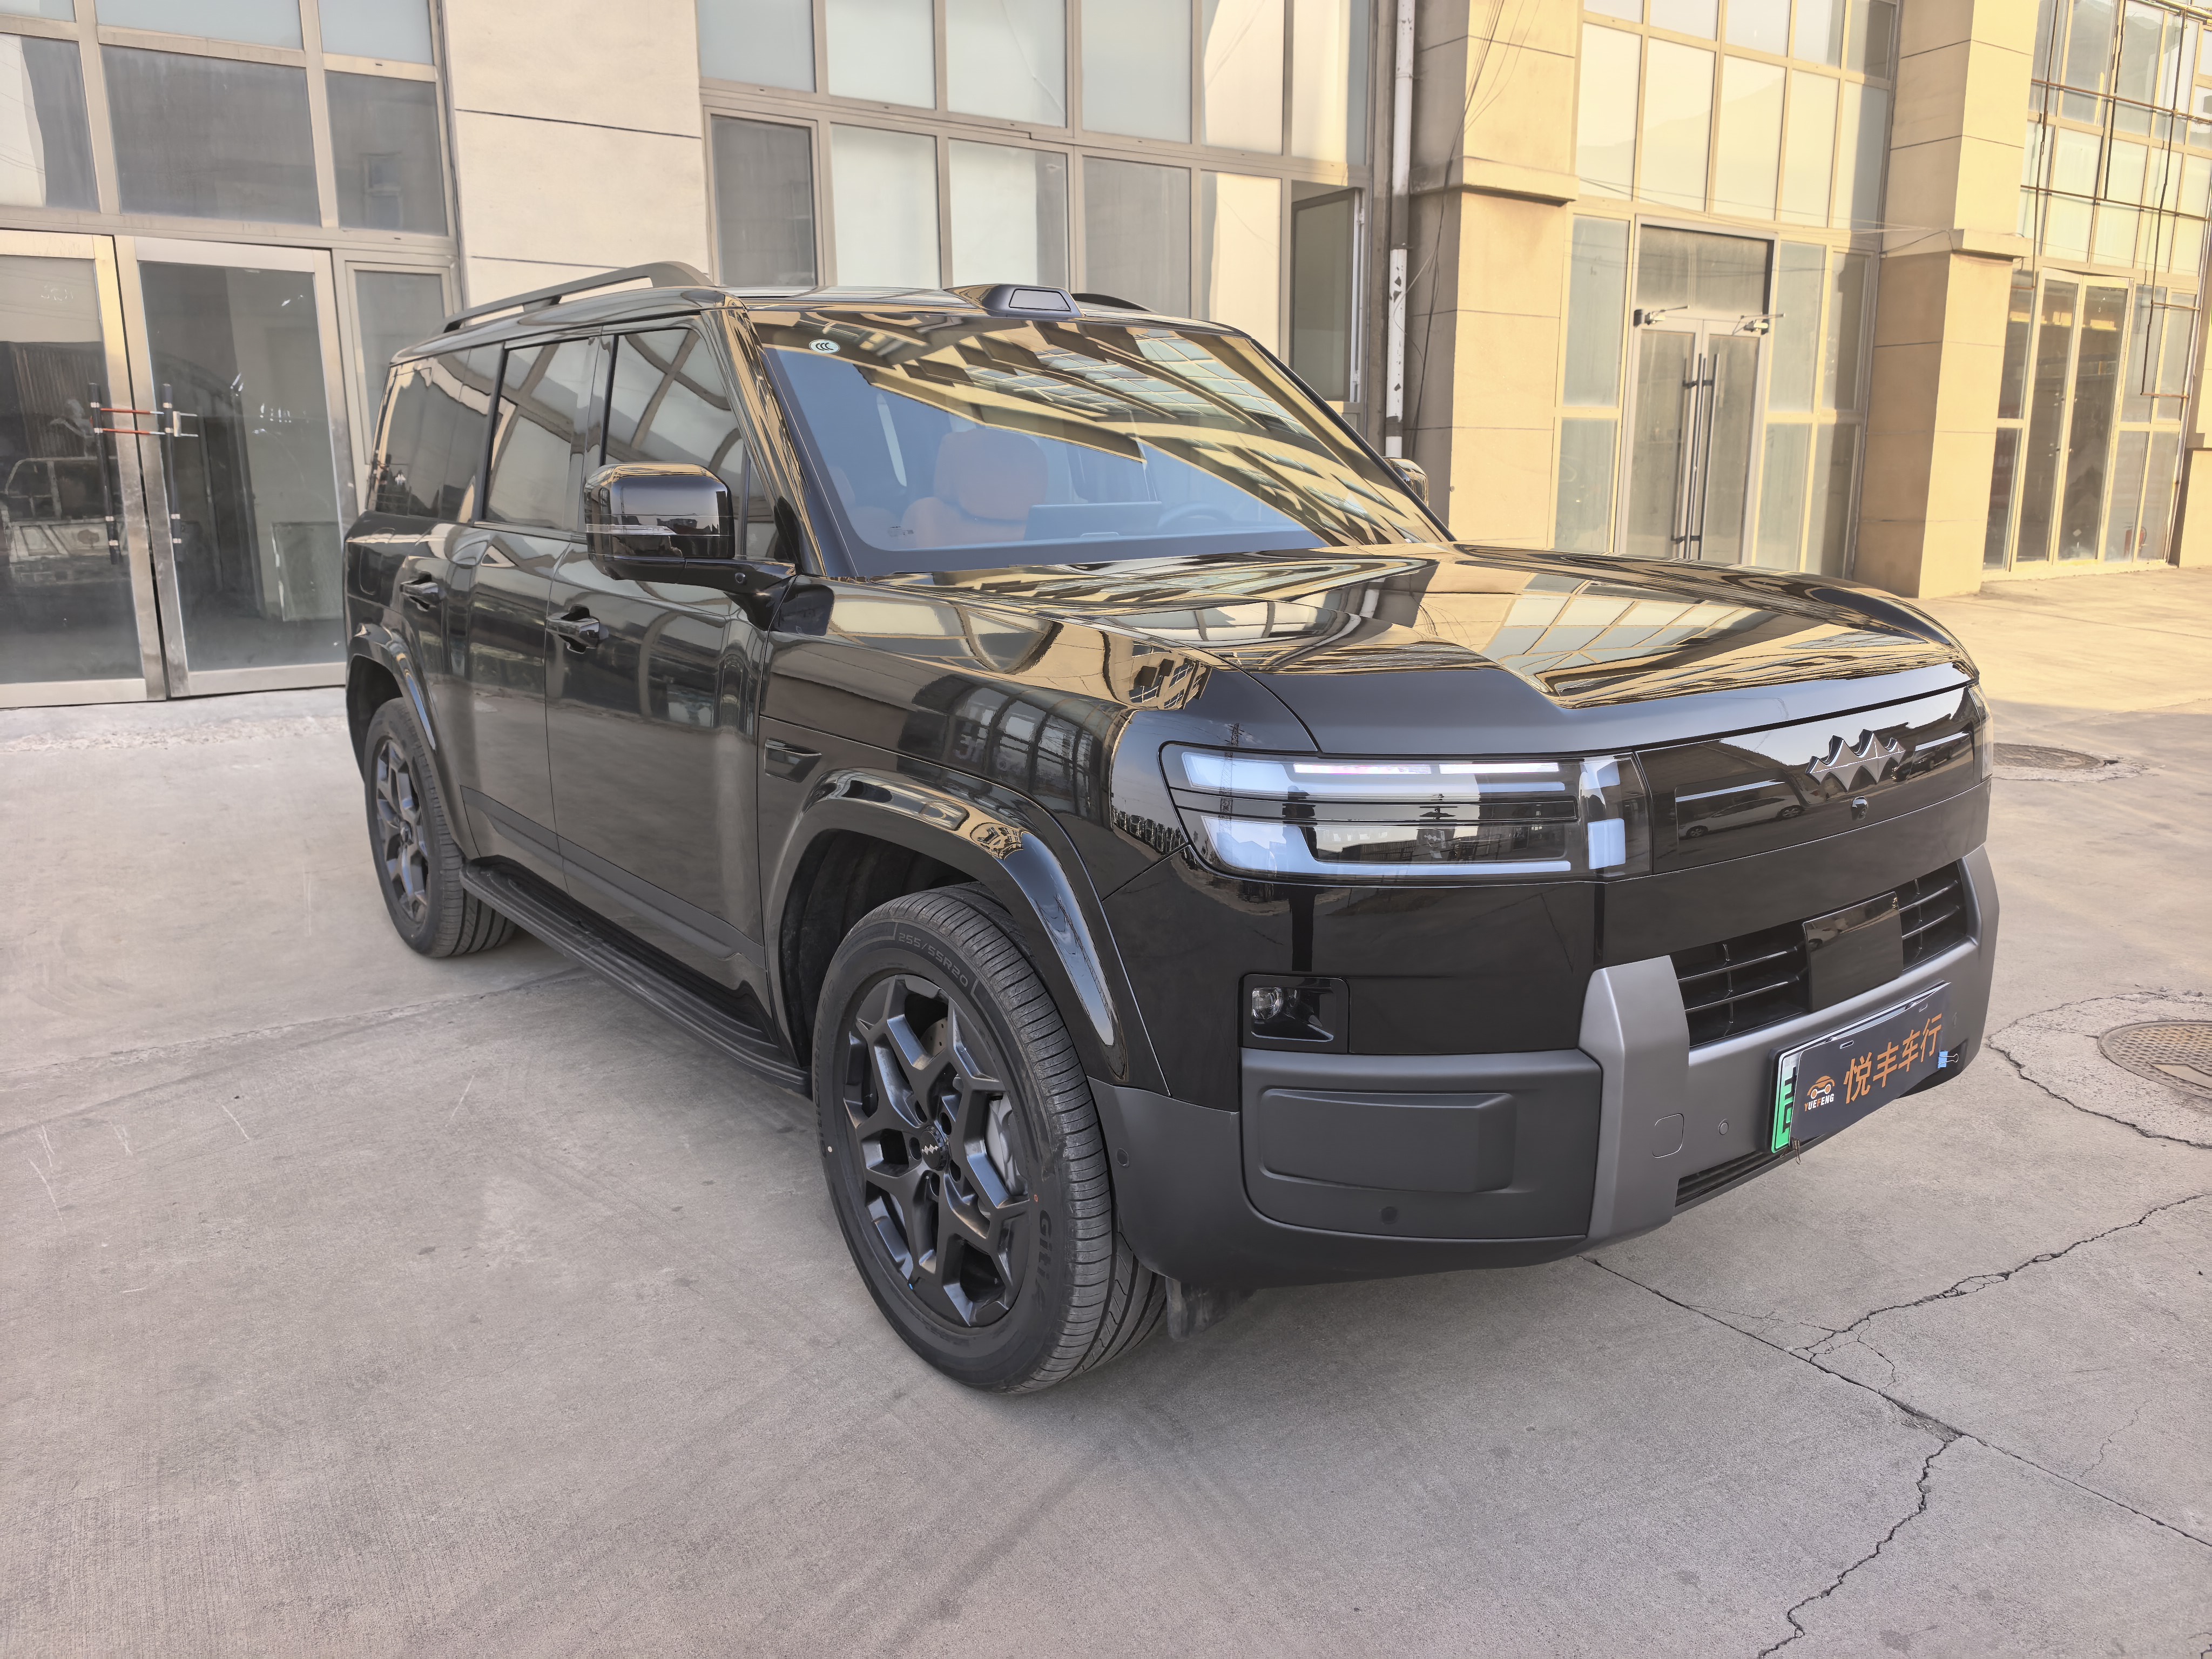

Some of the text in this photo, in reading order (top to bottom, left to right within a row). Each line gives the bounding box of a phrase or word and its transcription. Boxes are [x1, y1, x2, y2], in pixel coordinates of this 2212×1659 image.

[898, 933, 968, 987] 255/55R20
[1843, 1013, 1942, 1104] 悦丰车行
[1804, 1093, 1835, 1112] YUEFENG
[1037, 1210, 1053, 1280] Giti
